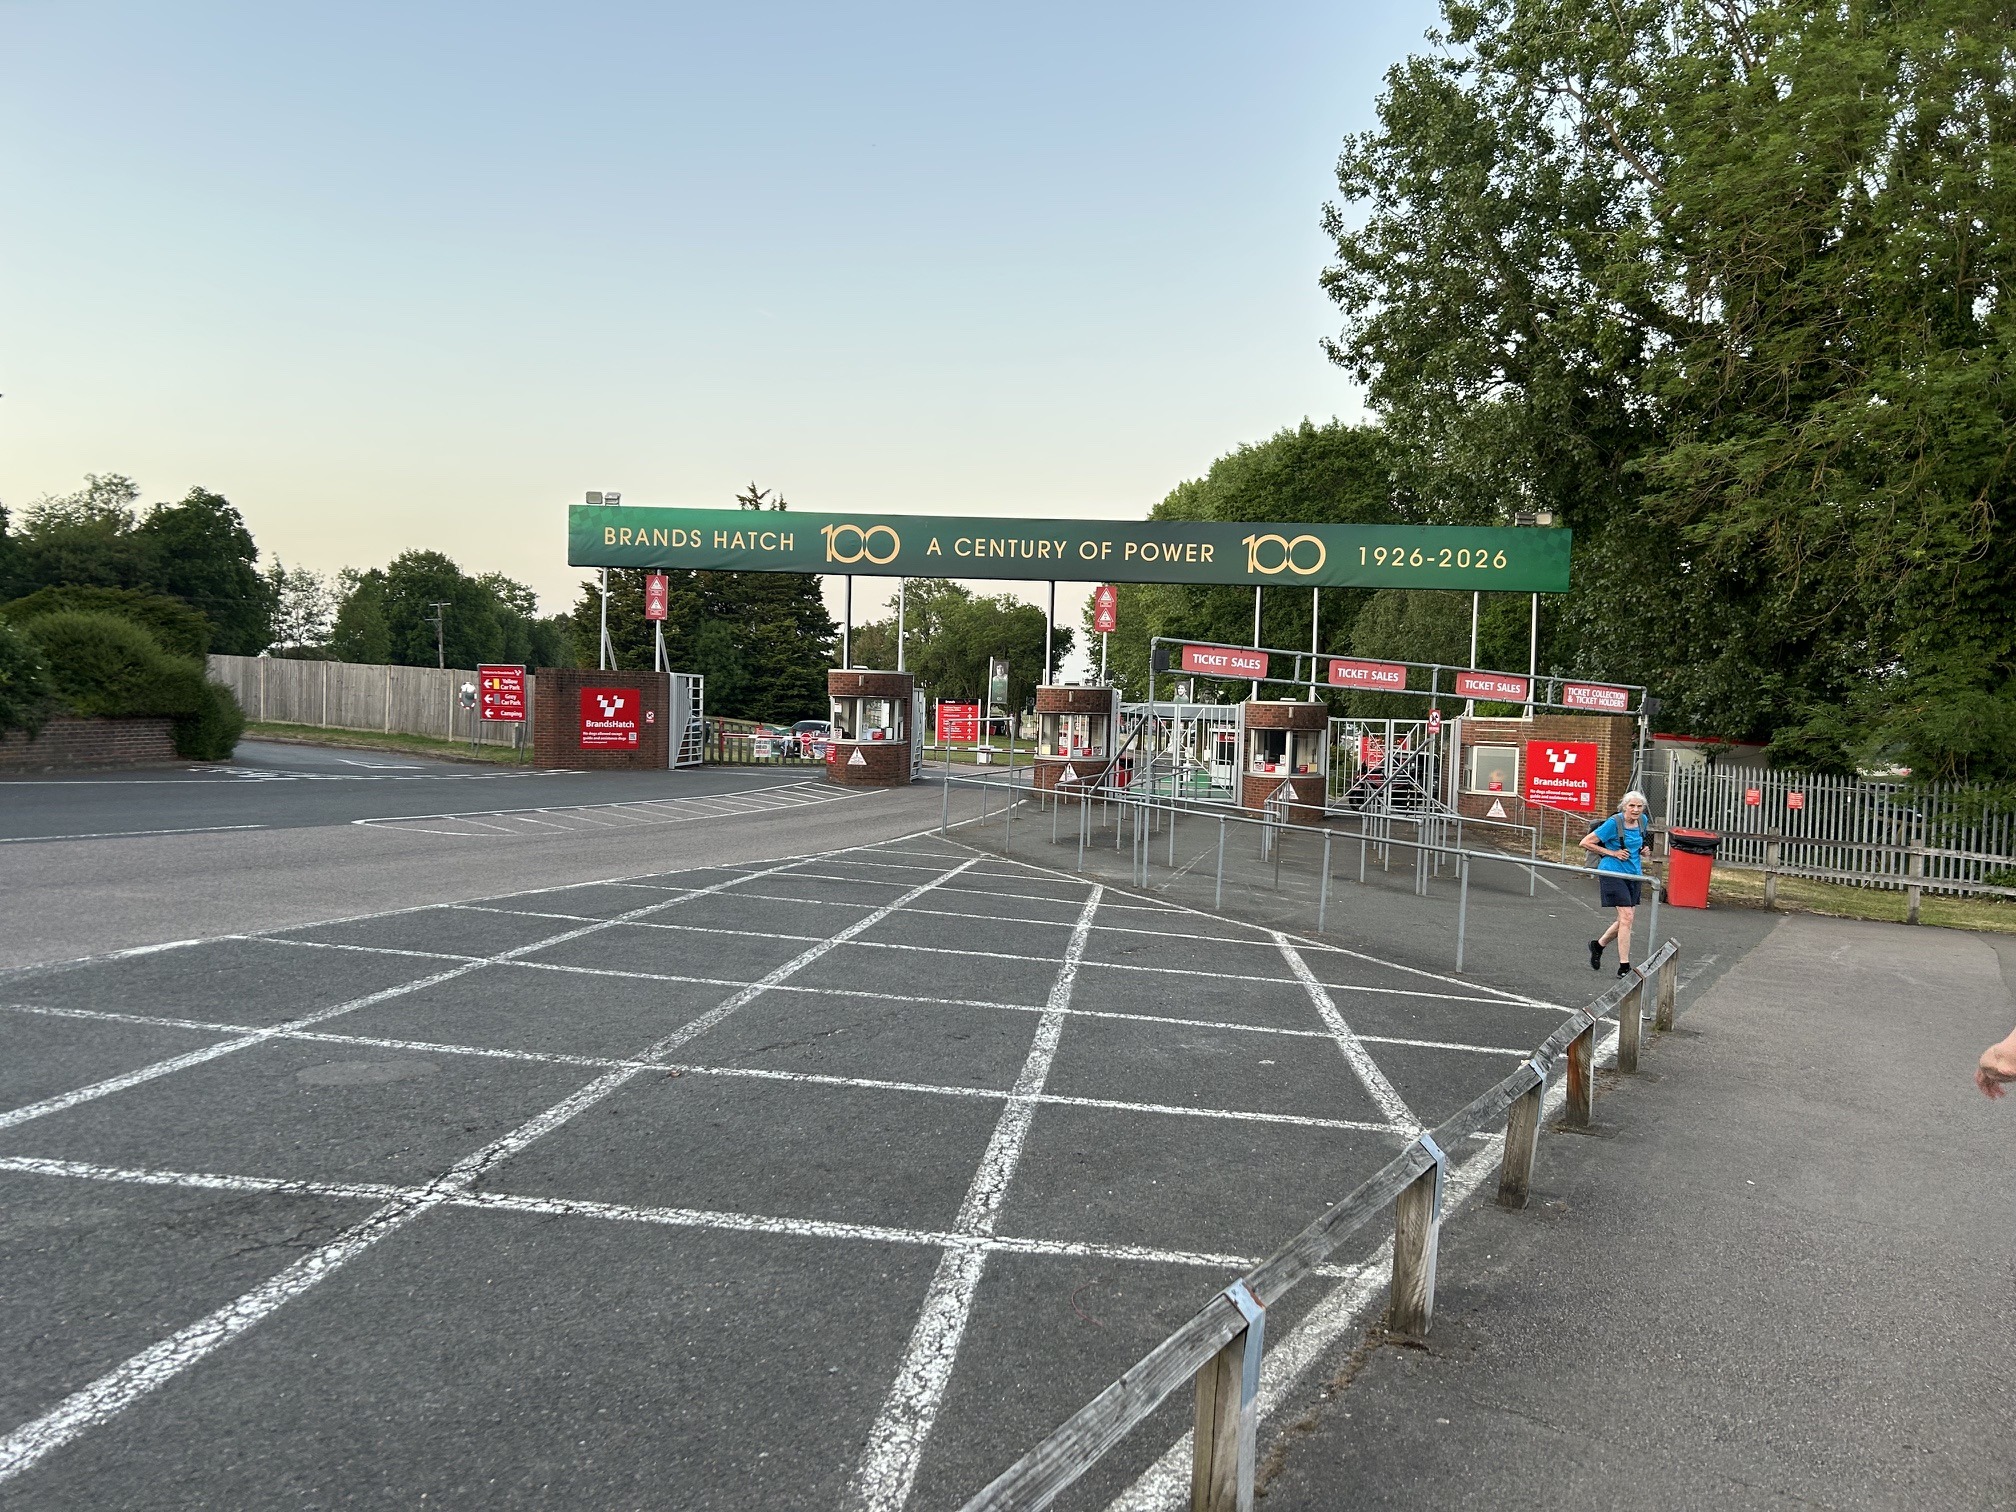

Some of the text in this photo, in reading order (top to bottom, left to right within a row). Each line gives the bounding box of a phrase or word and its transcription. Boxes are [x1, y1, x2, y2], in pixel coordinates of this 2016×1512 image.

[604, 523, 1508, 576] BRANDS HATCH 100 A CENTURY OF POWER 100 1926-2026
[1193, 653, 1261, 670] TICKET SALES
[1337, 668, 1399, 682] TICKET SALES
[1465, 679, 1521, 694] TICKET SALES
[1567, 687, 1626, 700] TICKET COLLECTION
[1576, 696, 1598, 705] TICKET
[1599, 698, 1625, 708] HOLDERS
[500, 710, 522, 718] Camping
[585, 719, 635, 728] BrandsHatch
[1533, 777, 1588, 788] BrandsHatch
